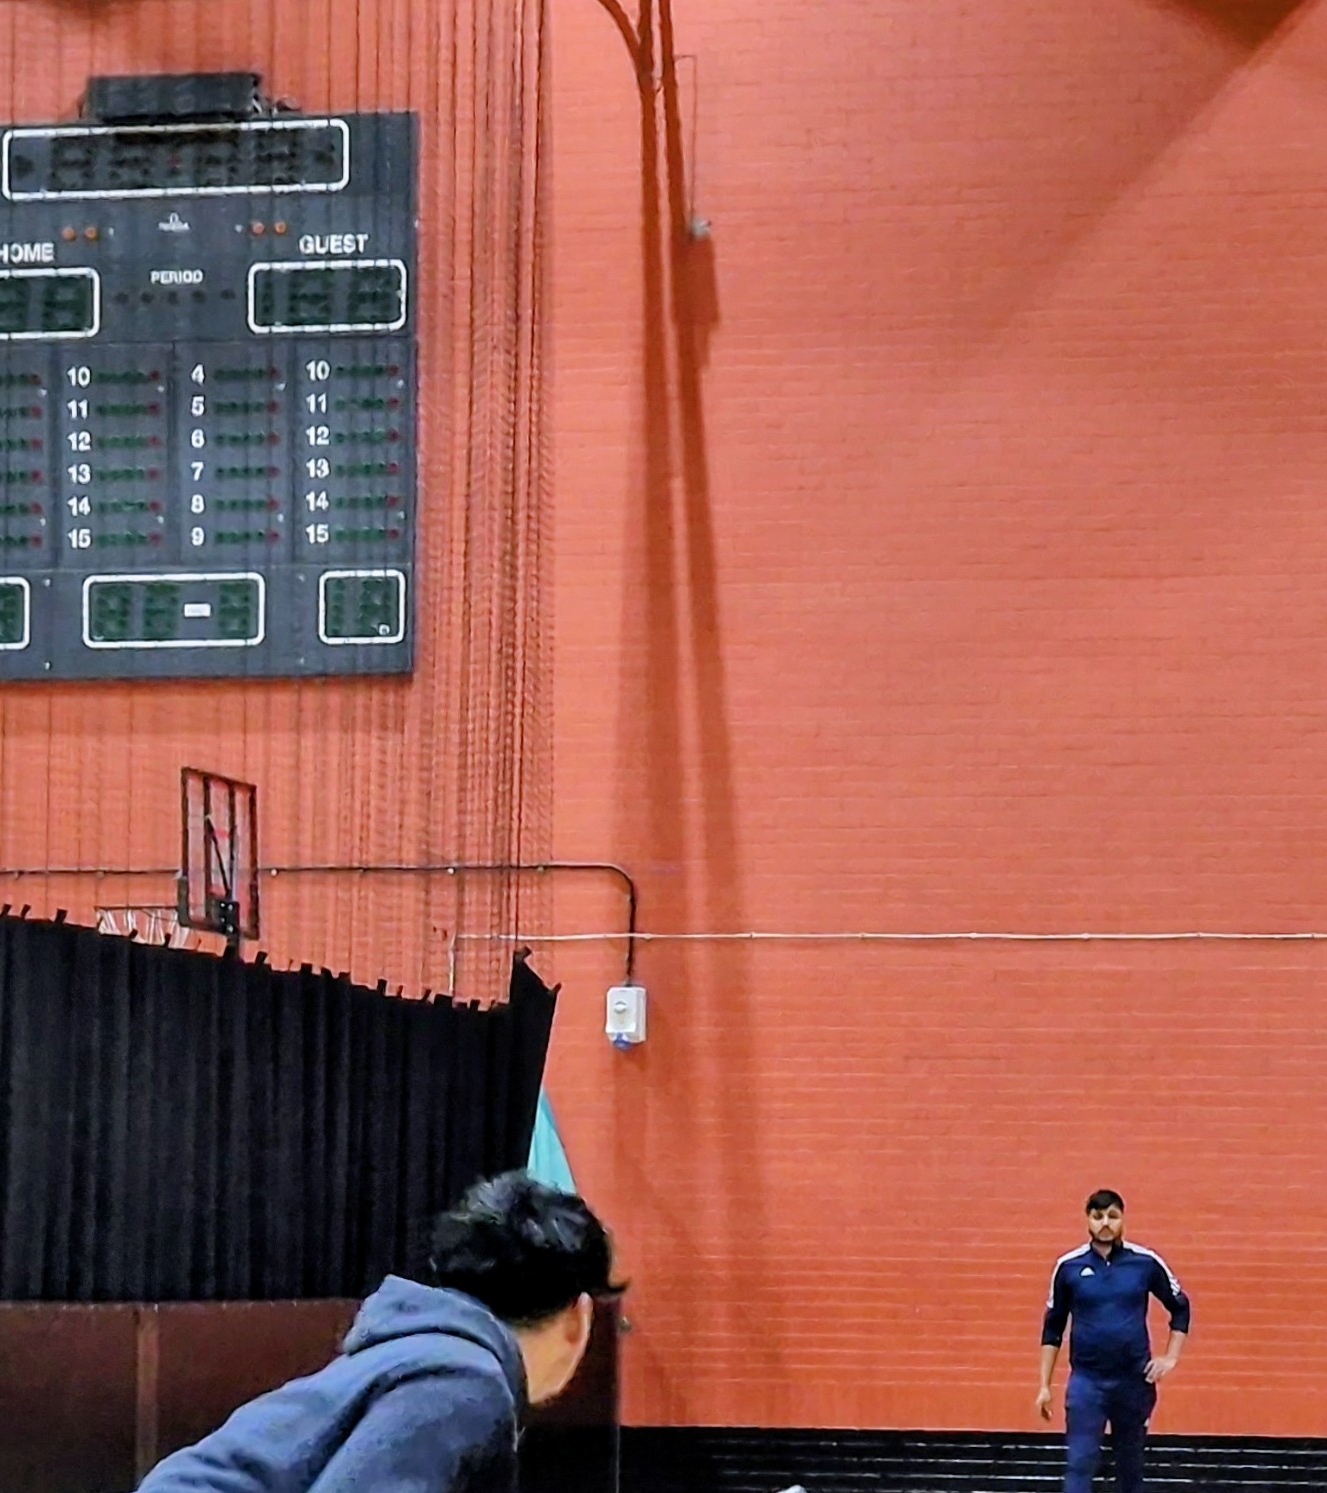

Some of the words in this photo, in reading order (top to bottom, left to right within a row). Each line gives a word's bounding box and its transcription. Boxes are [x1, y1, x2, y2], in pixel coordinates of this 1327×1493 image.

[298, 233, 369, 255] GUEST
[150, 269, 204, 285] PERIOD
[67, 366, 91, 387] 10
[191, 364, 205, 385] 4
[306, 360, 330, 382] 10
[67, 399, 88, 420] 11
[191, 395, 205, 417] 5
[305, 392, 327, 414] 11
[67, 431, 91, 452] 12
[191, 428, 205, 449] 6
[305, 425, 330, 447] 12
[67, 463, 91, 485] 13
[190, 461, 204, 482] 7
[305, 458, 330, 479] 13
[67, 495, 91, 517] 14
[190, 493, 205, 514] 8
[305, 490, 330, 513] 14
[67, 528, 91, 549] 15
[190, 526, 205, 547] 9
[305, 523, 330, 545] 15
